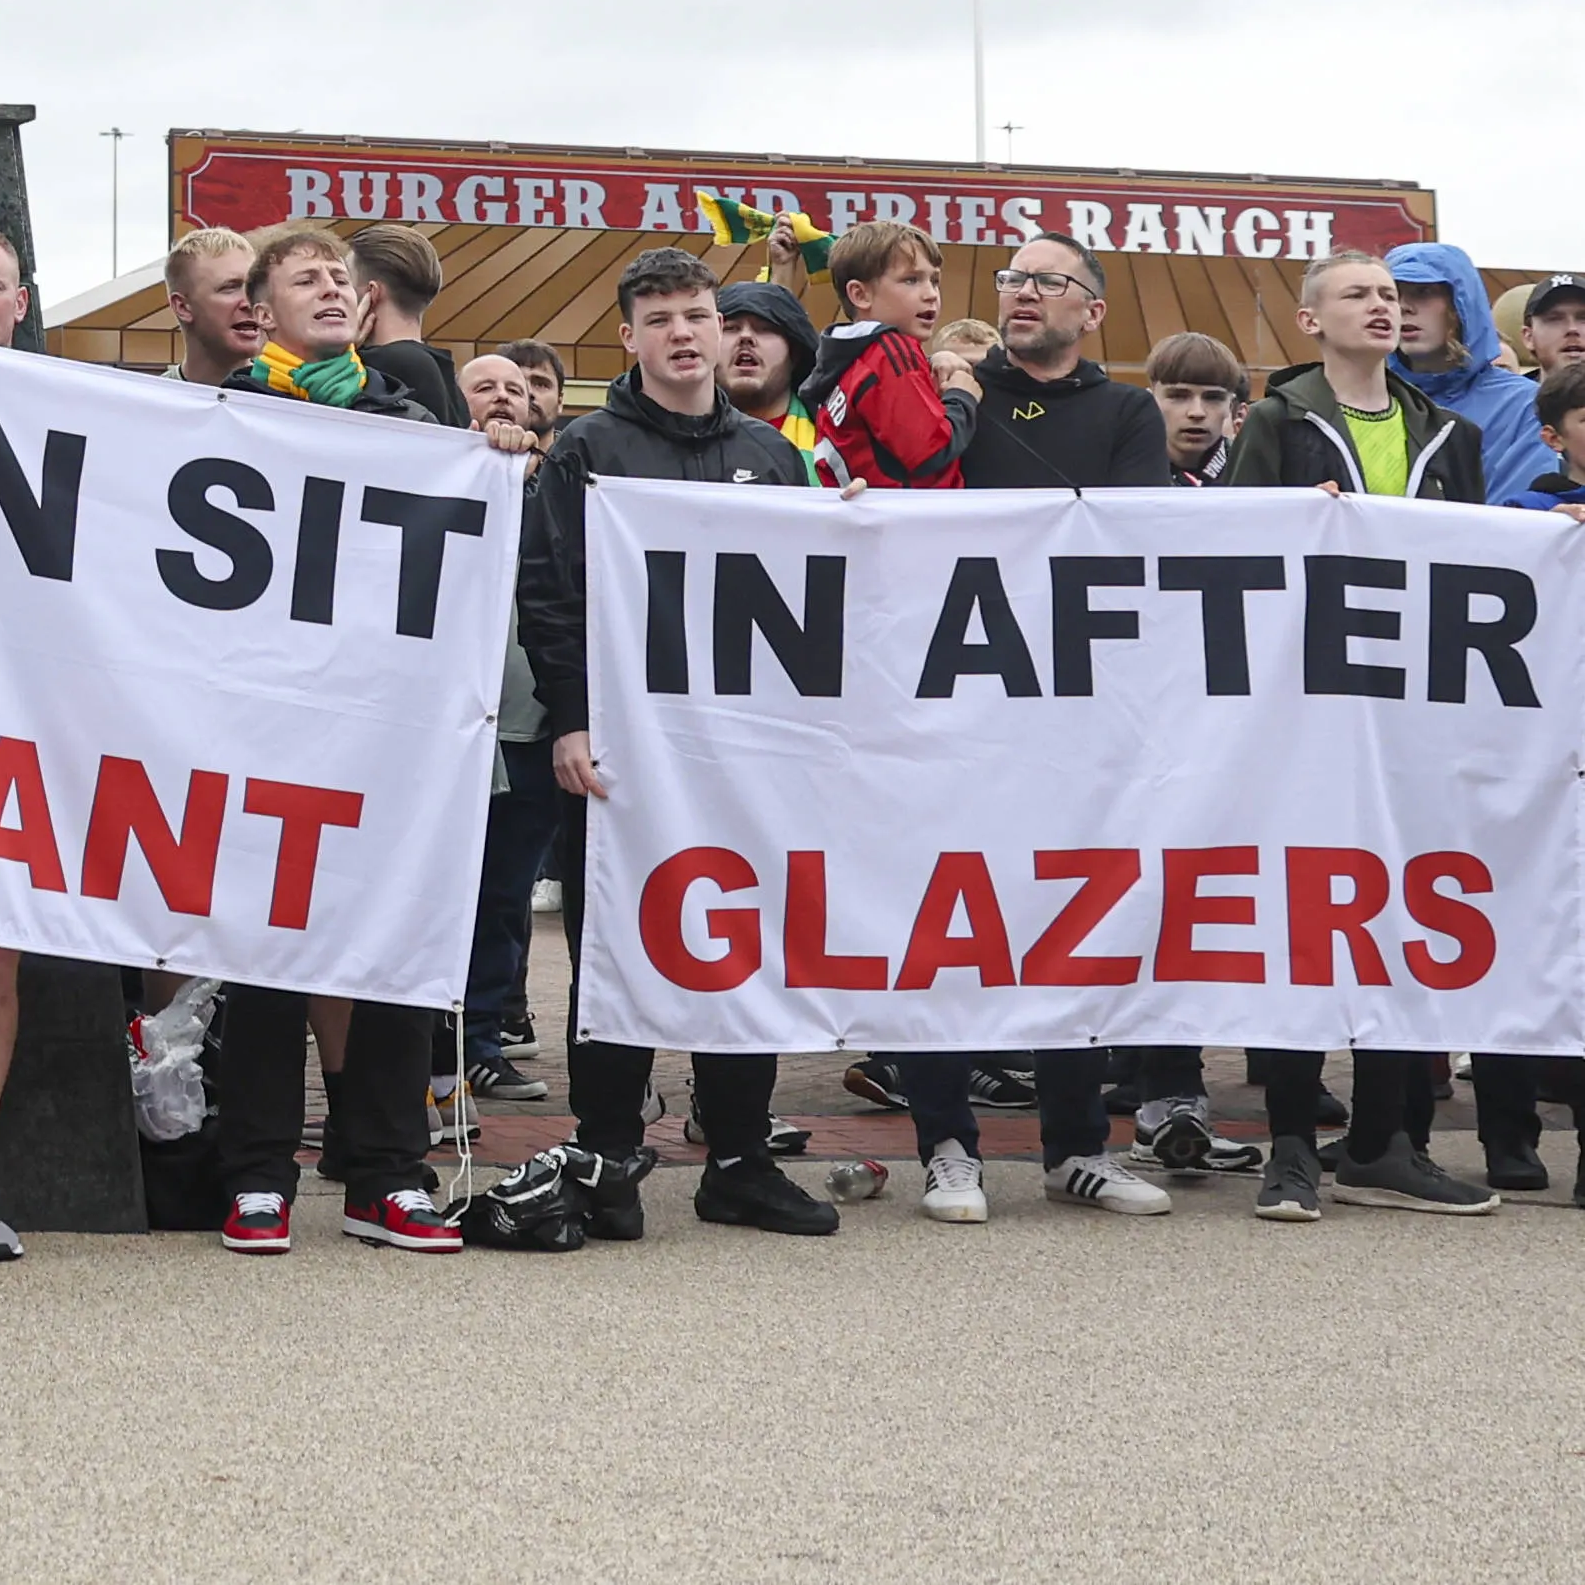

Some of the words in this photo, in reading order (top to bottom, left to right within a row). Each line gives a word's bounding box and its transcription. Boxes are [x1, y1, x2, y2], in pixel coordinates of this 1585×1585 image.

[284, 167, 607, 230] BURGER
[640, 182, 802, 235] AND
[826, 191, 1043, 247] FRIES
[1065, 199, 1335, 260] RANCH
[155, 457, 488, 640] SIT
[644, 550, 847, 698] IN
[914, 554, 1543, 709] AFTER
[639, 845, 1496, 993] GLAZERS
